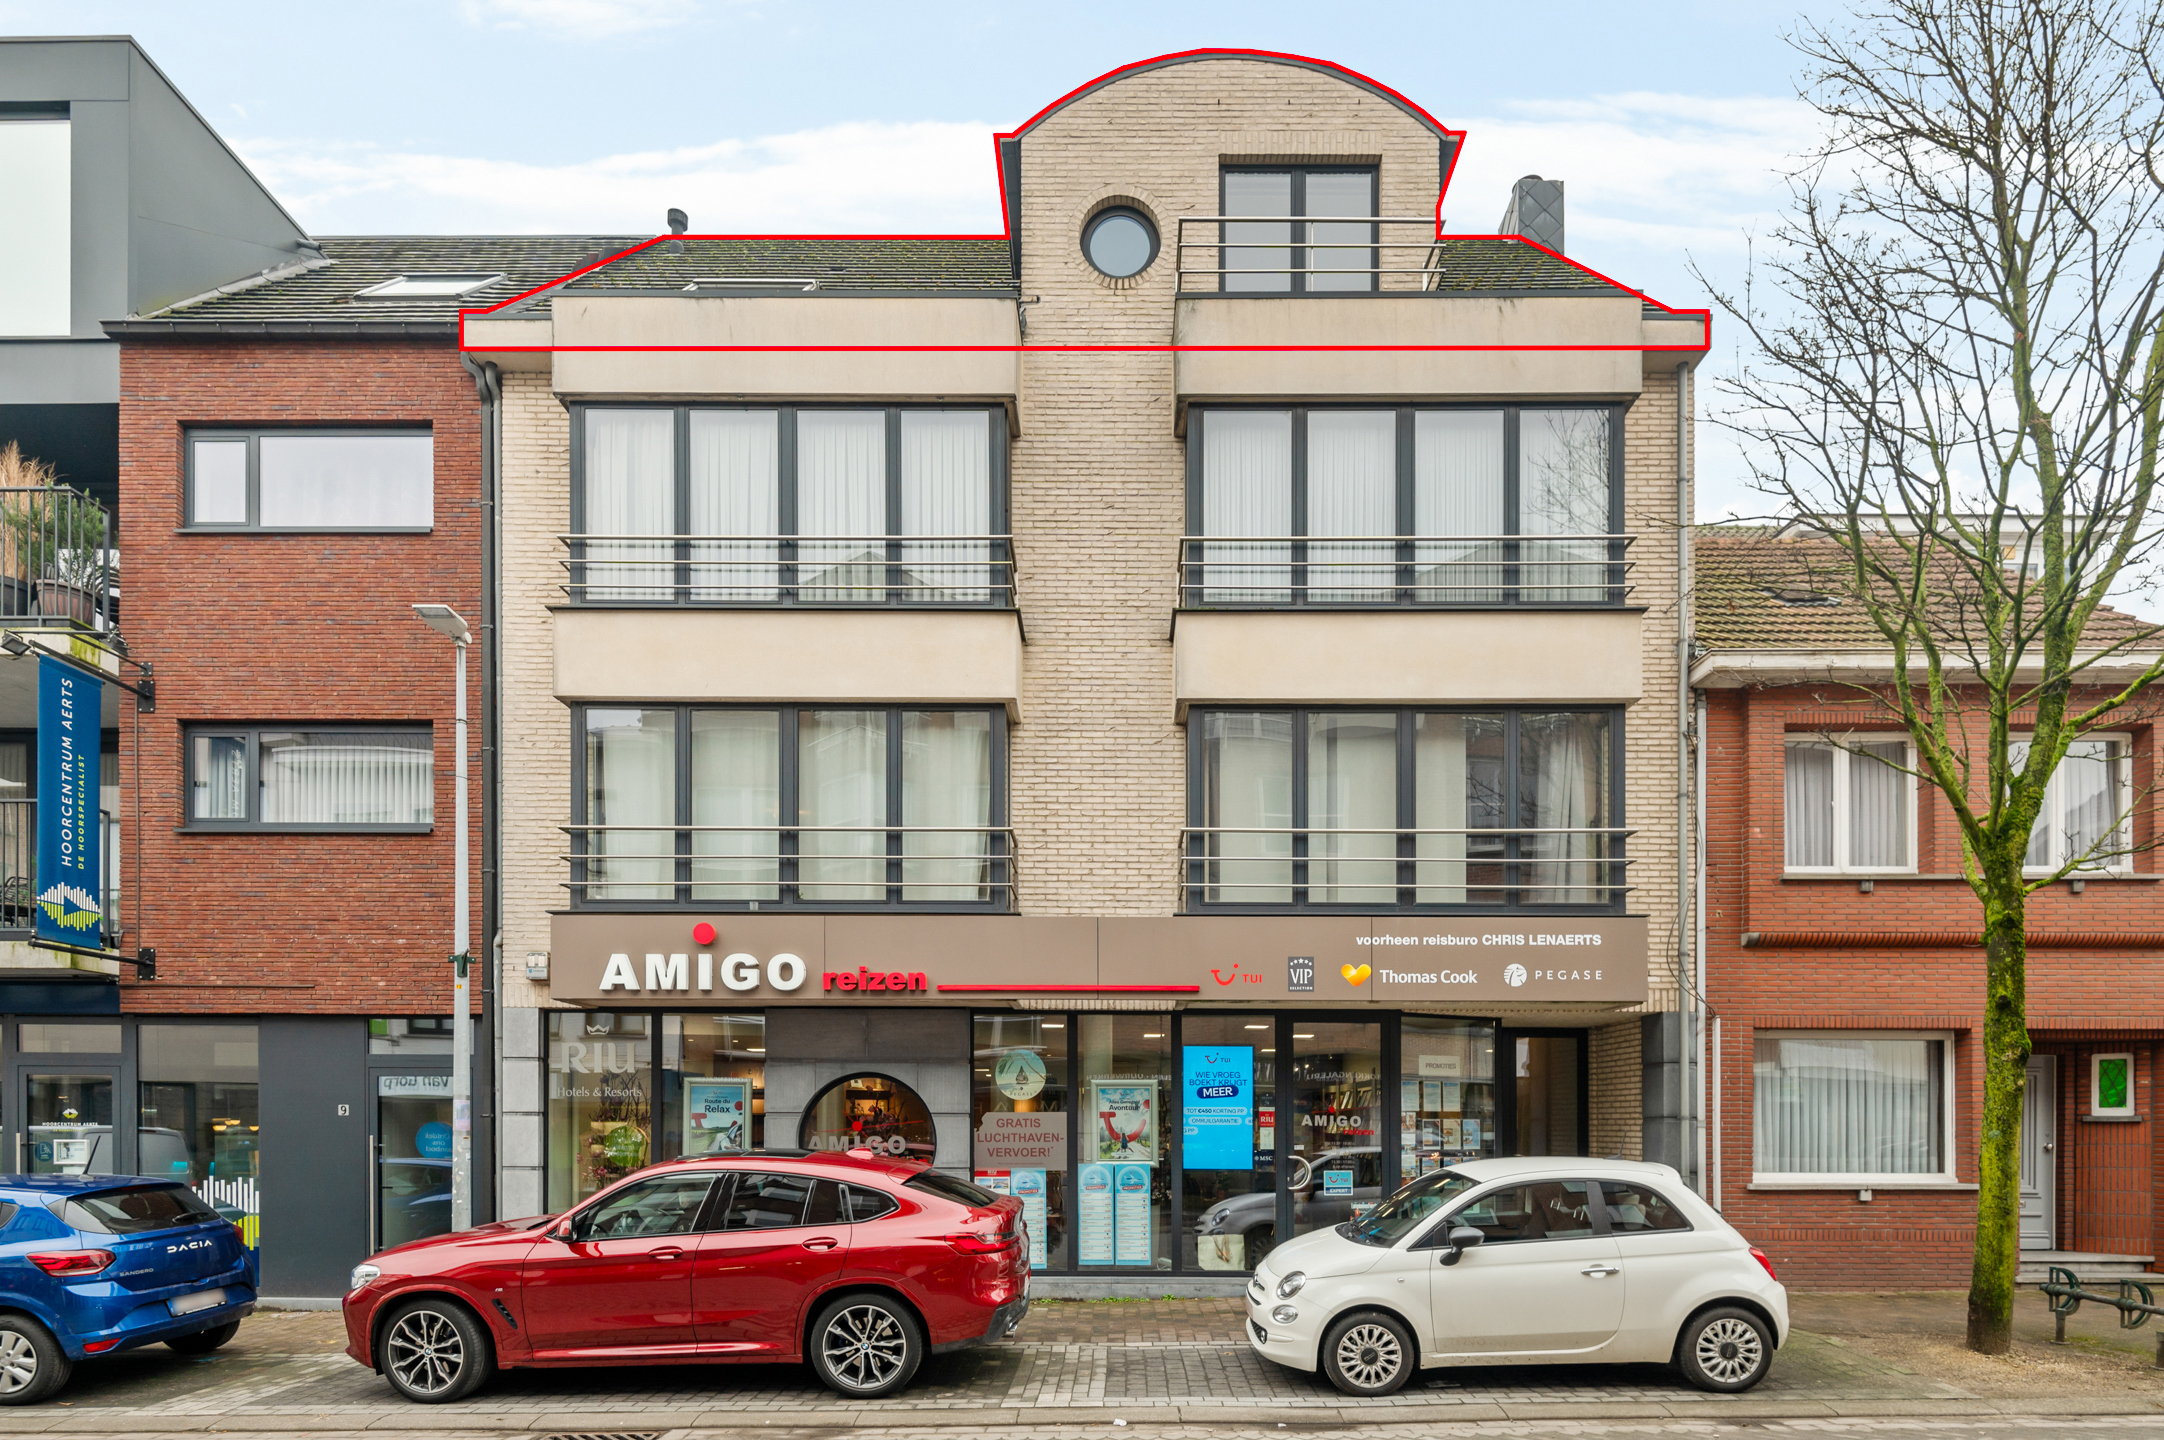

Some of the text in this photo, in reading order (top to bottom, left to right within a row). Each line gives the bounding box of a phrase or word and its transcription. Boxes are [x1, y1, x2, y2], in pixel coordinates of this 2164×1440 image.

[62, 677, 73, 866] HOORCENTRUM AERTS
[78, 856, 85, 869] DE
[1356, 934, 1602, 946] voorheen reisburo CHRIS LENAERTS
[599, 952, 928, 992] AMIGO reizen
[1290, 968, 1313, 985] VIP
[1379, 969, 1478, 984] Thomas Cook
[1535, 970, 1602, 980] PEGASE
[1242, 974, 1262, 984] TUI
[561, 1042, 637, 1074] RIU
[1425, 1062, 1457, 1070] PROMOTIES
[1195, 1071, 1241, 1079] WIE VROEG
[1218, 1079, 1248, 1087] KRIJGT
[557, 1086, 642, 1097] Hotels & Resorts
[1202, 1086, 1234, 1098] MEER
[340, 1105, 347, 1115] 9
[704, 1104, 731, 1113] Relax
[996, 1118, 1042, 1129] GRATIS
[1260, 1115, 1274, 1123] RIU
[1301, 1114, 1362, 1128] AMIGO
[1343, 1127, 1375, 1136] reizen
[977, 1132, 1065, 1143] LUCHTHAVEN-
[808, 1135, 907, 1155] AMIGO
[167, 1240, 213, 1254] DACIA
[119, 1267, 154, 1277] SANDERO
